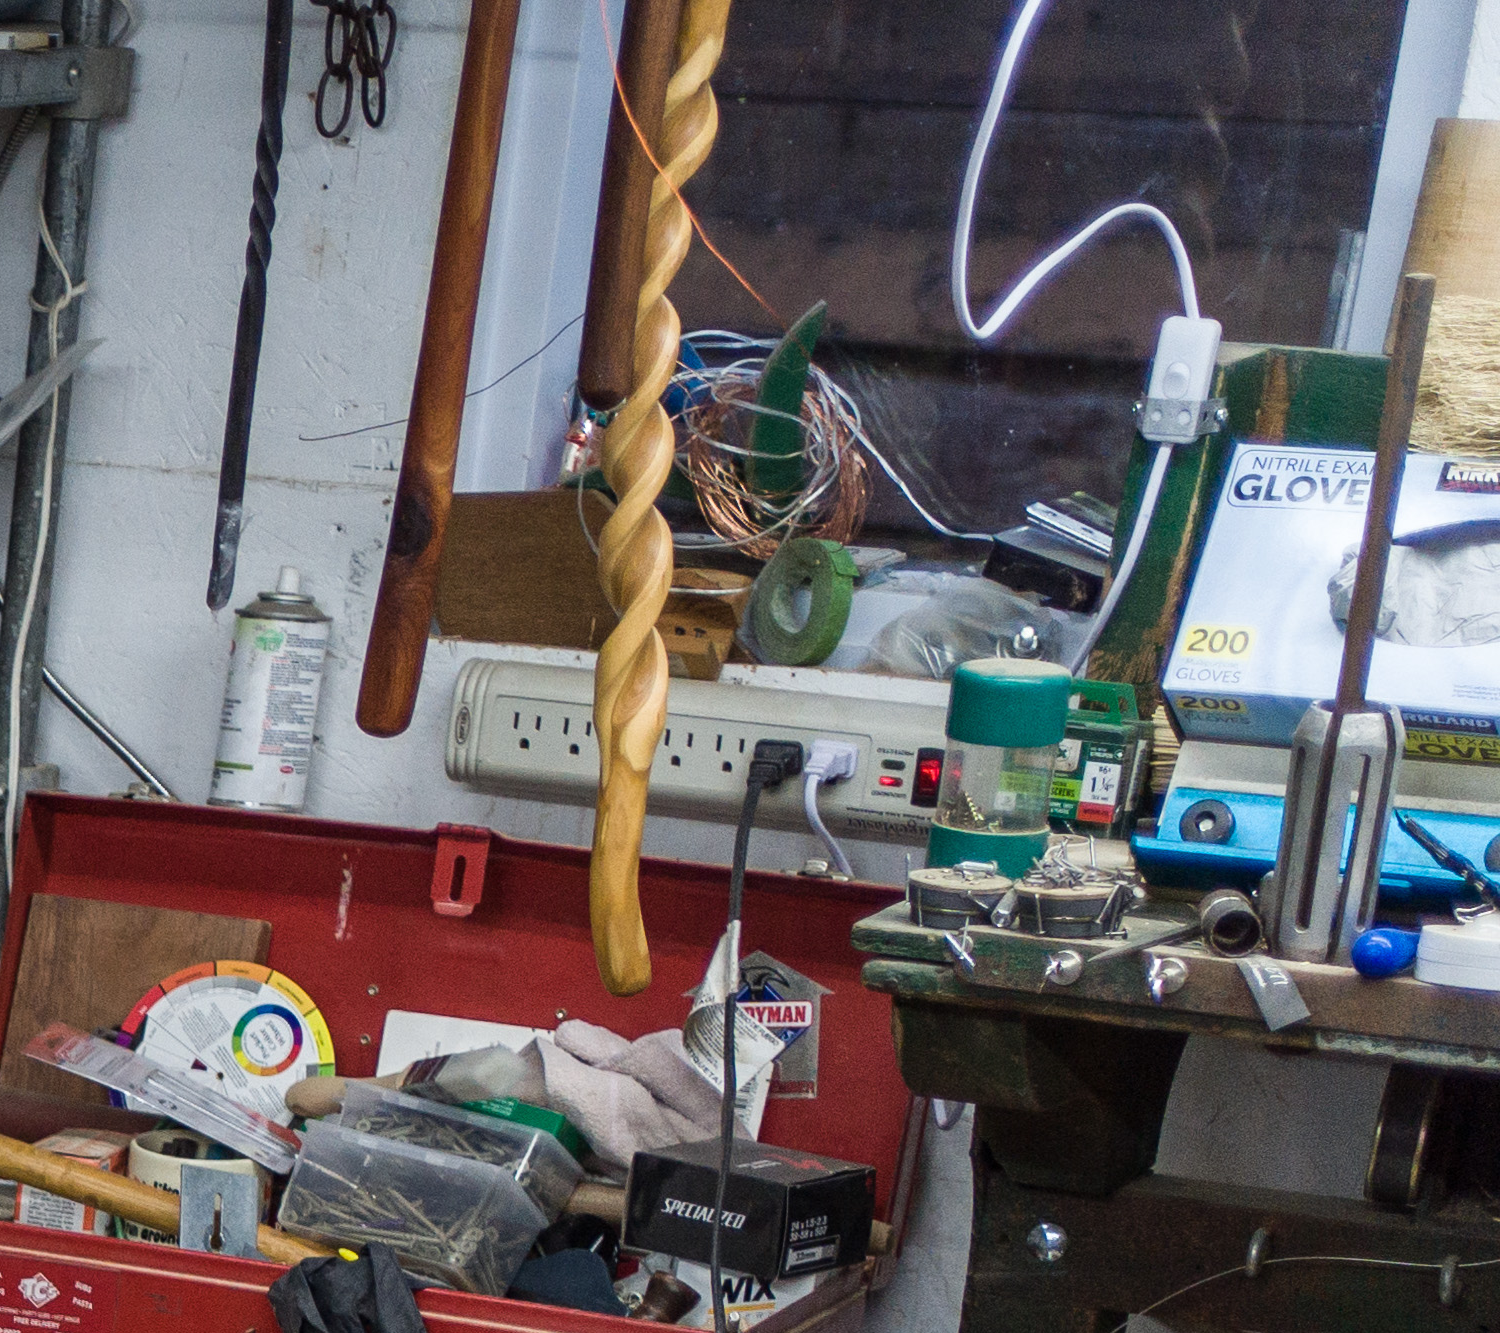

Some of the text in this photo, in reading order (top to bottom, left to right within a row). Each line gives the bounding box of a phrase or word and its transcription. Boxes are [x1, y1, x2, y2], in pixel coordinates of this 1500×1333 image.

[1252, 456, 1328, 473] NITRILE
[1233, 474, 1371, 506] GLOVE
[1187, 628, 1250, 655] 200
[1176, 667, 1241, 684] GLOVES
[1180, 695, 1241, 711] 200
[1403, 713, 1492, 728] RKLAND
[661, 1197, 746, 1230] SPECIALZED
[140, 1227, 180, 1246] aroun
